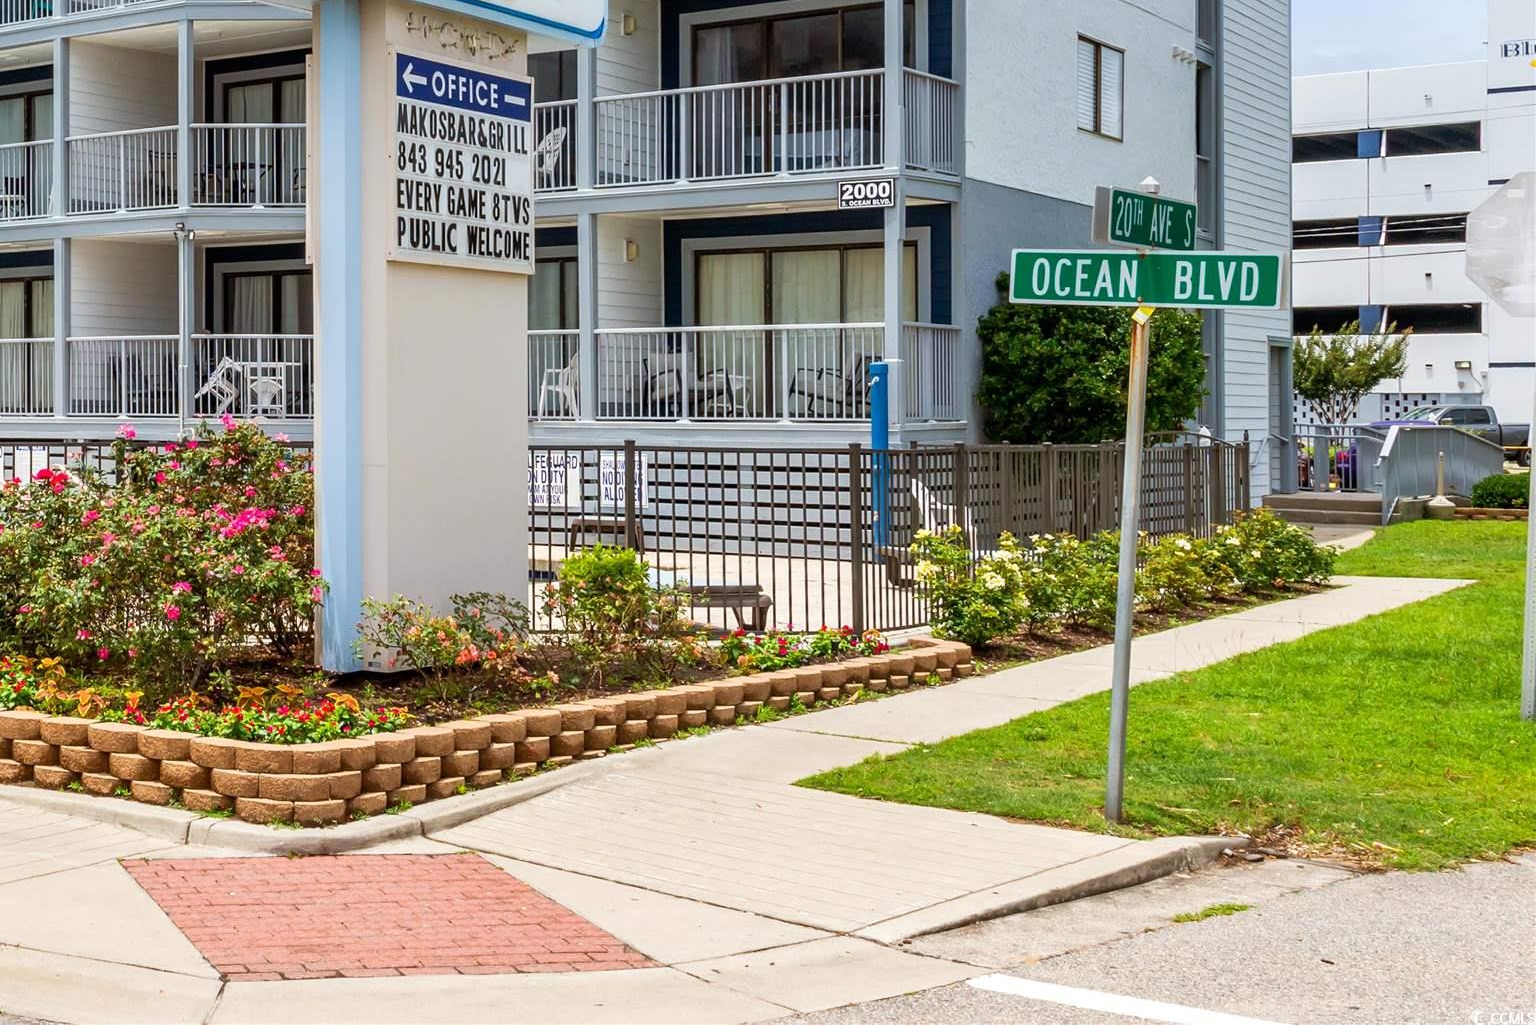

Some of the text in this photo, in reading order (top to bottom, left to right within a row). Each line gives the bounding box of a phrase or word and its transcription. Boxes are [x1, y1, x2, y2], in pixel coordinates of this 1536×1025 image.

[431, 70, 498, 108] OFFICE
[397, 102, 528, 155] MAKOSBAR&GRILL
[397, 141, 506, 186] 843 945 2021
[397, 178, 530, 225] EVERY GAME 8TVS
[842, 182, 890, 199] 2000
[397, 216, 530, 260] PUBLIC WELCOME
[1115, 195, 1192, 248] 20TH AVE S
[1031, 258, 1260, 302] OCEAN BLVD
[602, 471, 613, 485] NO
